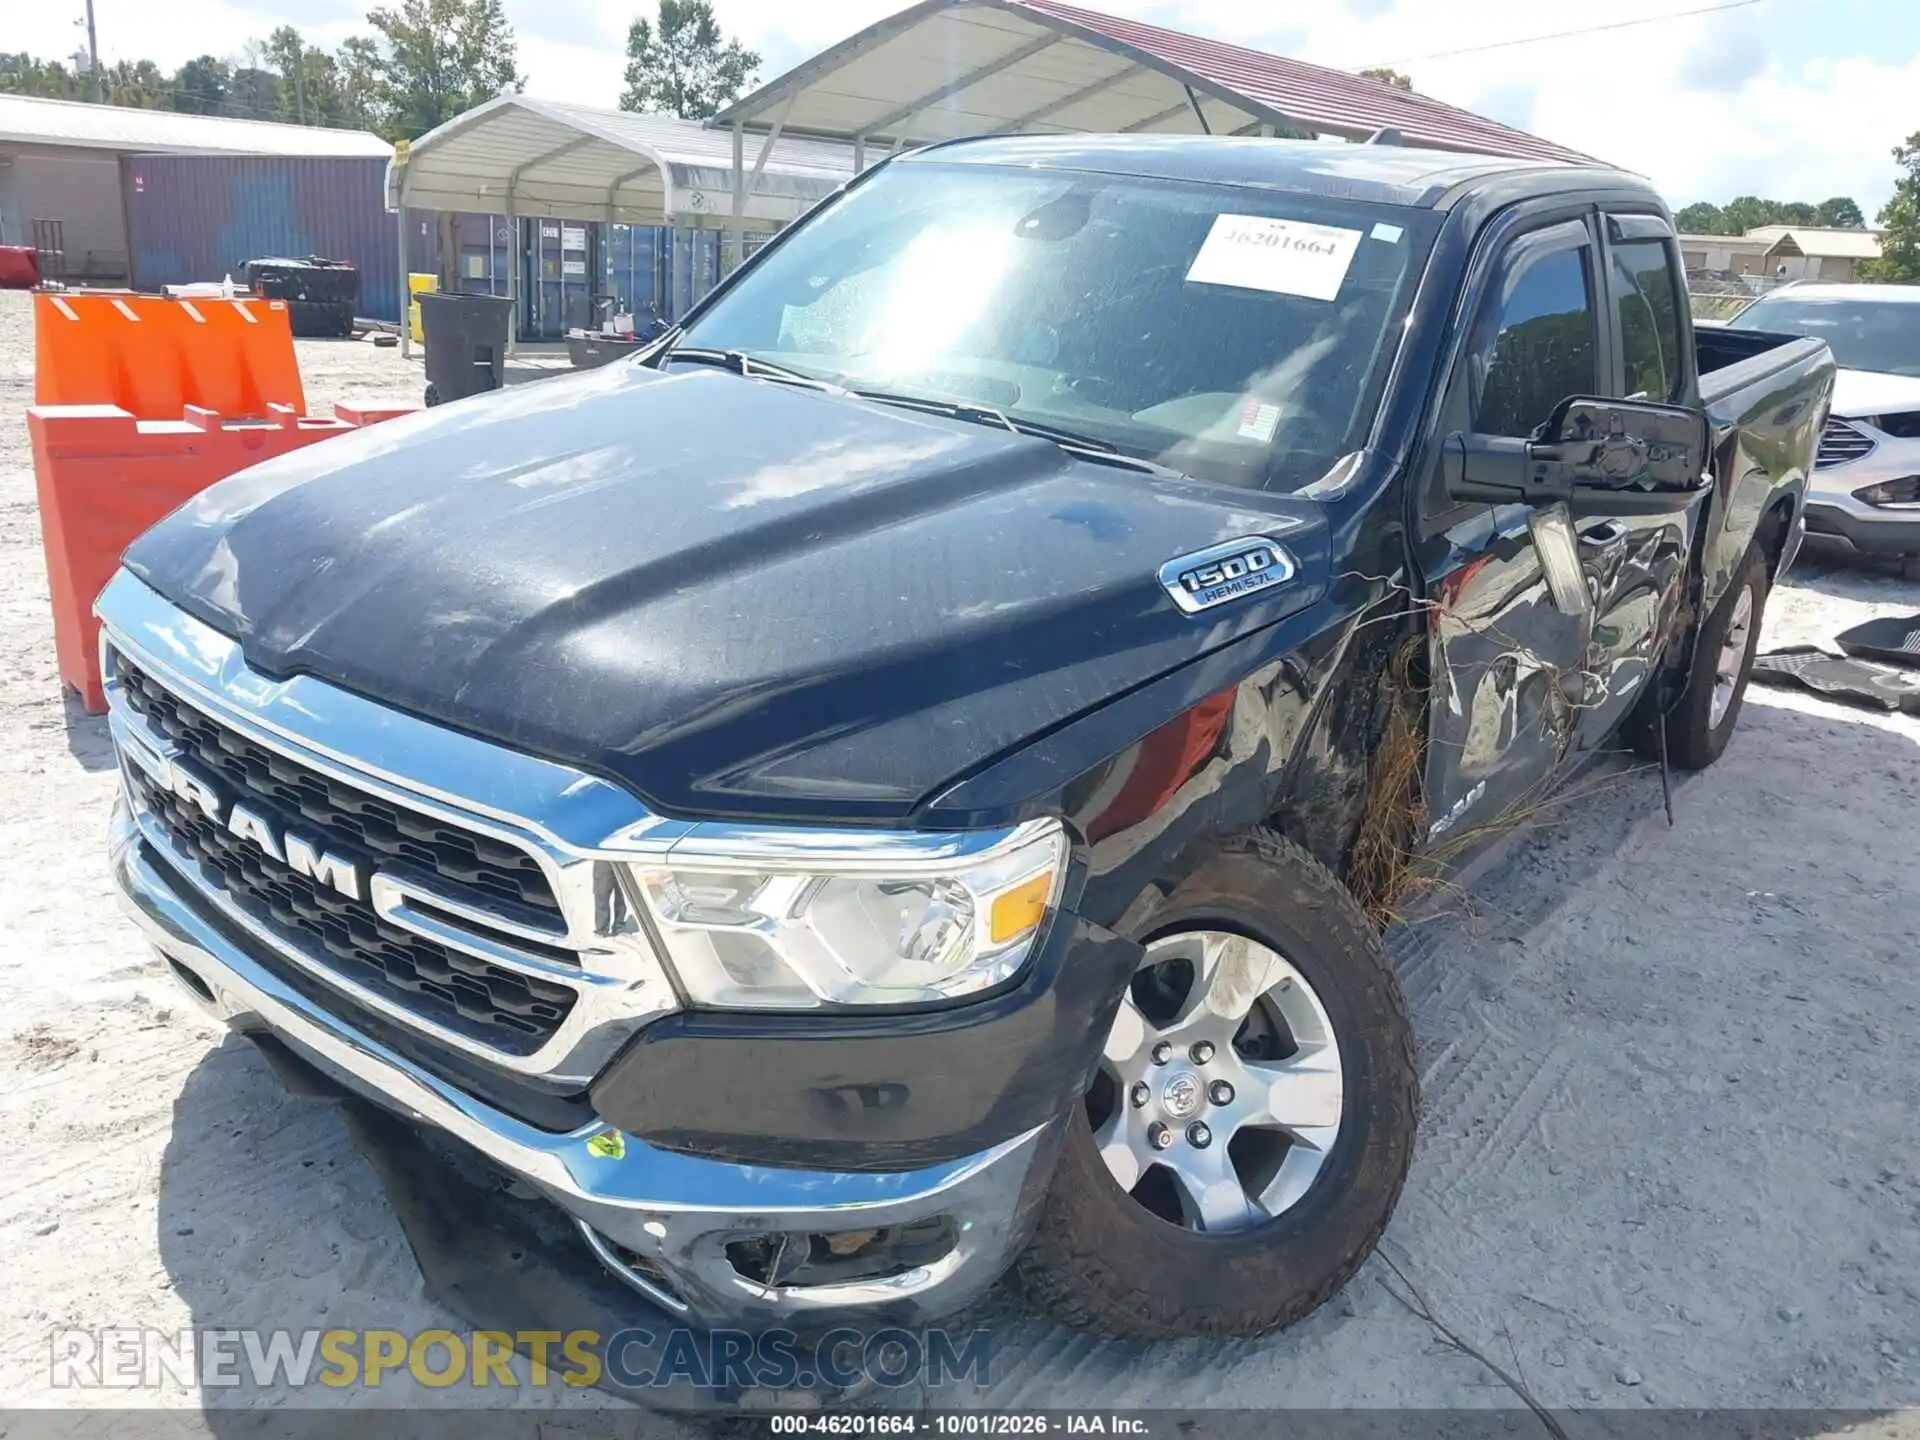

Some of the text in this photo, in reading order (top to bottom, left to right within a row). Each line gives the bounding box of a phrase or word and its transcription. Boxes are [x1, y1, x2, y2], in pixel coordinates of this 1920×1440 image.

[1181, 549, 1271, 592] 1500
[1204, 583, 1243, 602] HEMI
[171, 754, 360, 900] RAM
